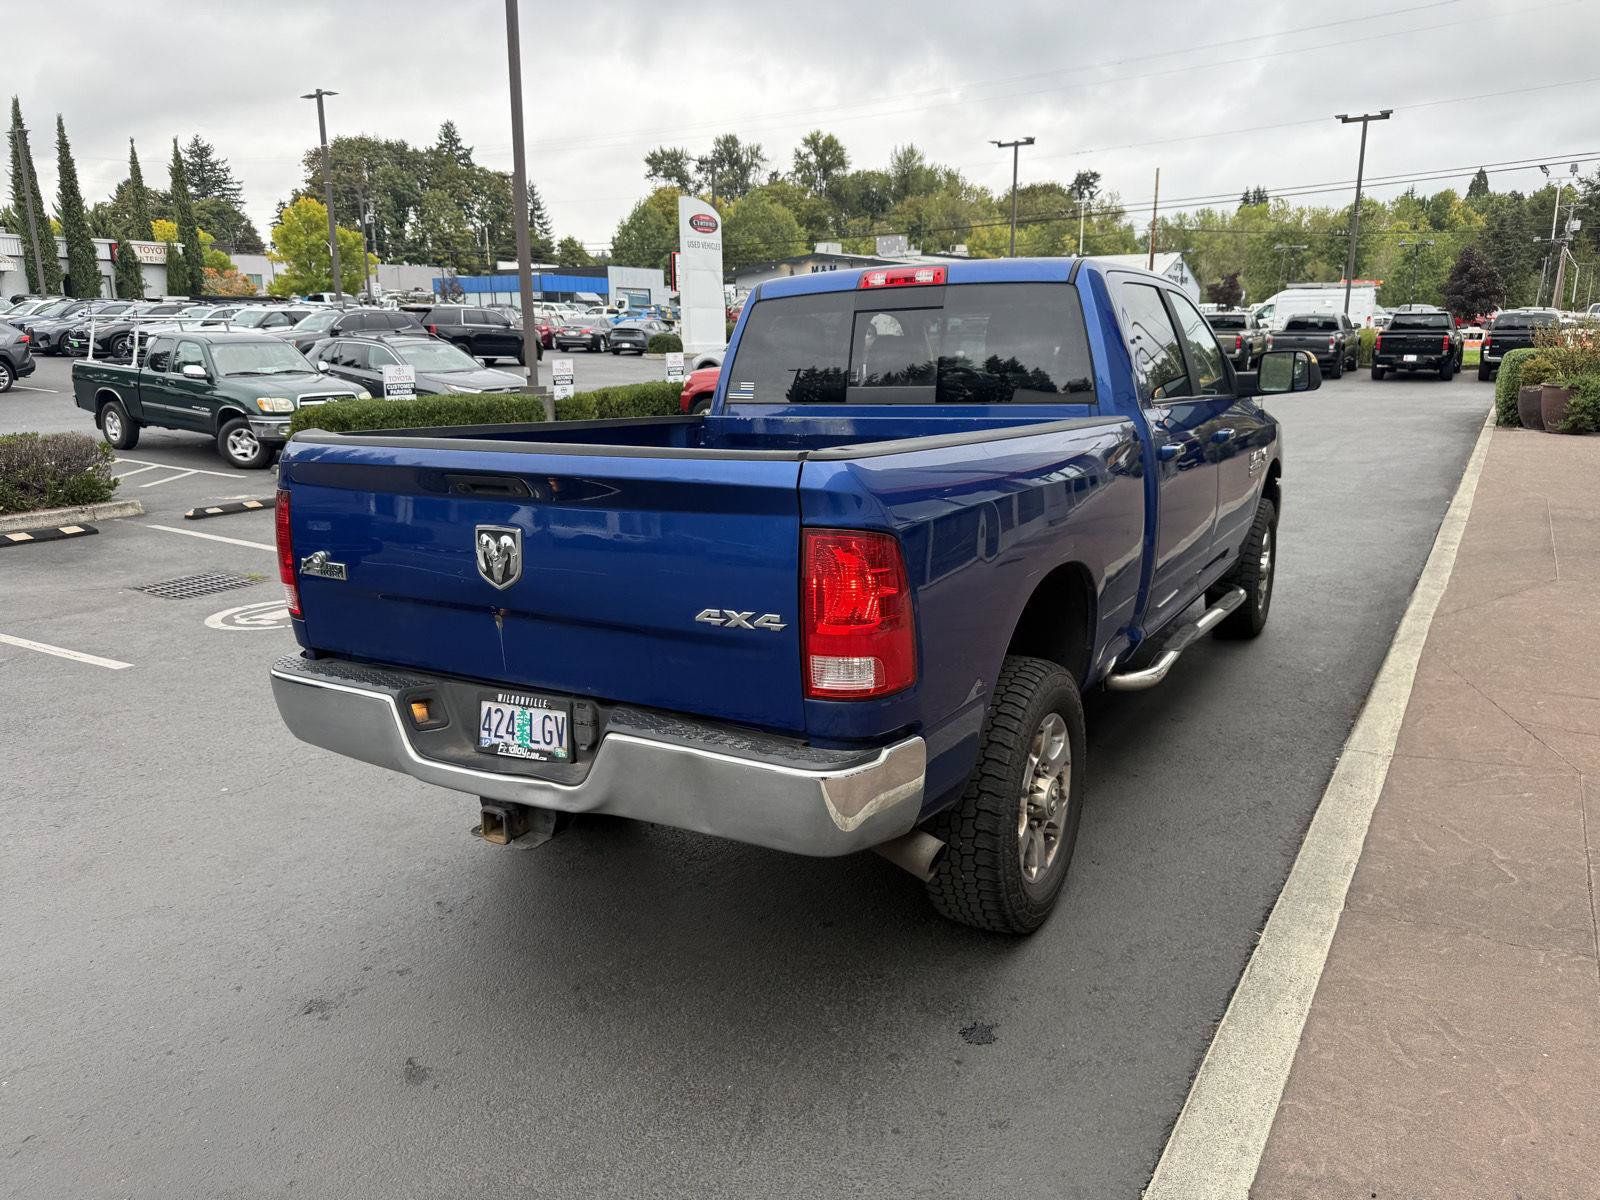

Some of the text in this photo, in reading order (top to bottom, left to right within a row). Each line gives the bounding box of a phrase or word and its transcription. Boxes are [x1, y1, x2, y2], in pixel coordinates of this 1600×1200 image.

[138, 246, 167, 255] TOYOT
[687, 240, 700, 249] USED
[497, 693, 548, 708] WILSONVILLE
[482, 706, 566, 747] 424 LGV
